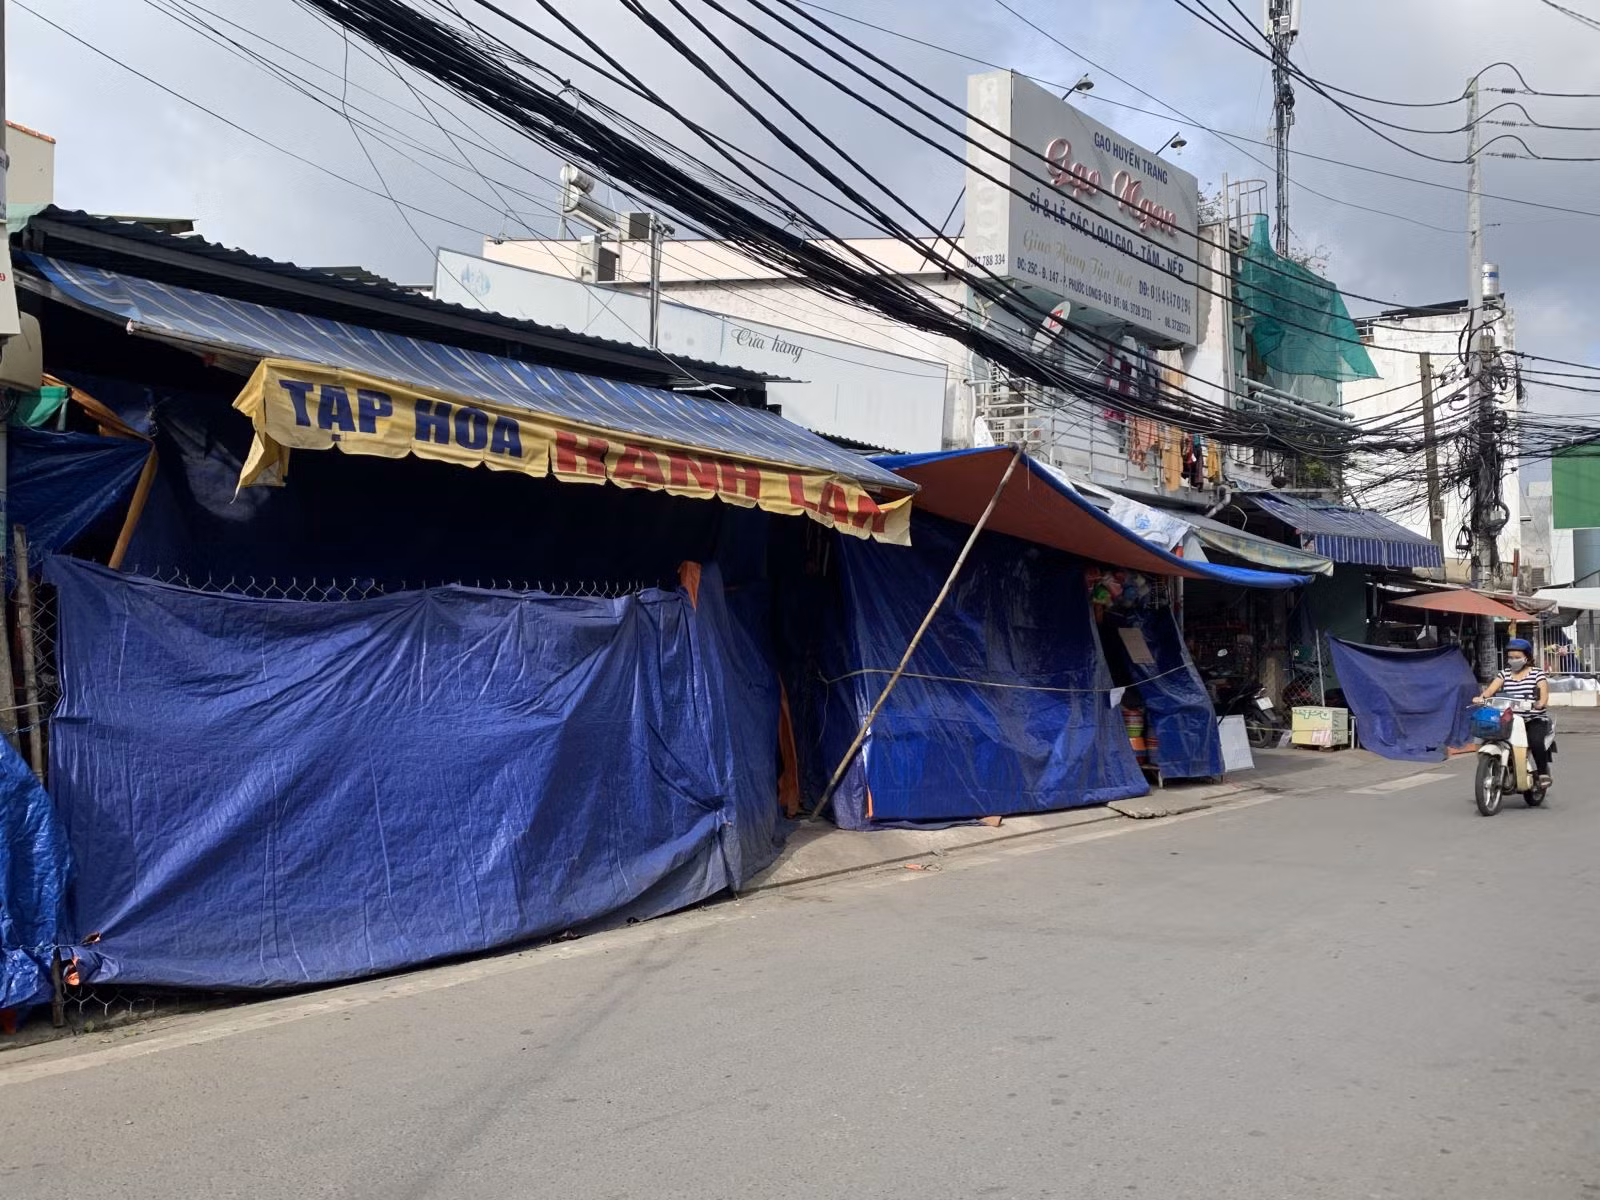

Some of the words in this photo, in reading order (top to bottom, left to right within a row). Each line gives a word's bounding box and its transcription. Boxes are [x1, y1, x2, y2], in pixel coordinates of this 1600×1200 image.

[1045, 138, 1101, 199] Gạo
[1112, 170, 1177, 235] Ngon
[1142, 158, 1168, 185] TRANG
[1029, 187, 1041, 214] SỈ
[1043, 198, 1051, 220] &
[1053, 200, 1067, 226] LẺ
[1070, 212, 1089, 237] CÁC
[1167, 256, 1184, 277] NẾP
[982, 255, 993, 267] 788
[994, 253, 1005, 266] 334
[1049, 270, 1059, 284] 147
[771, 333, 805, 364] hàng
[279, 379, 393, 443] TẠP
